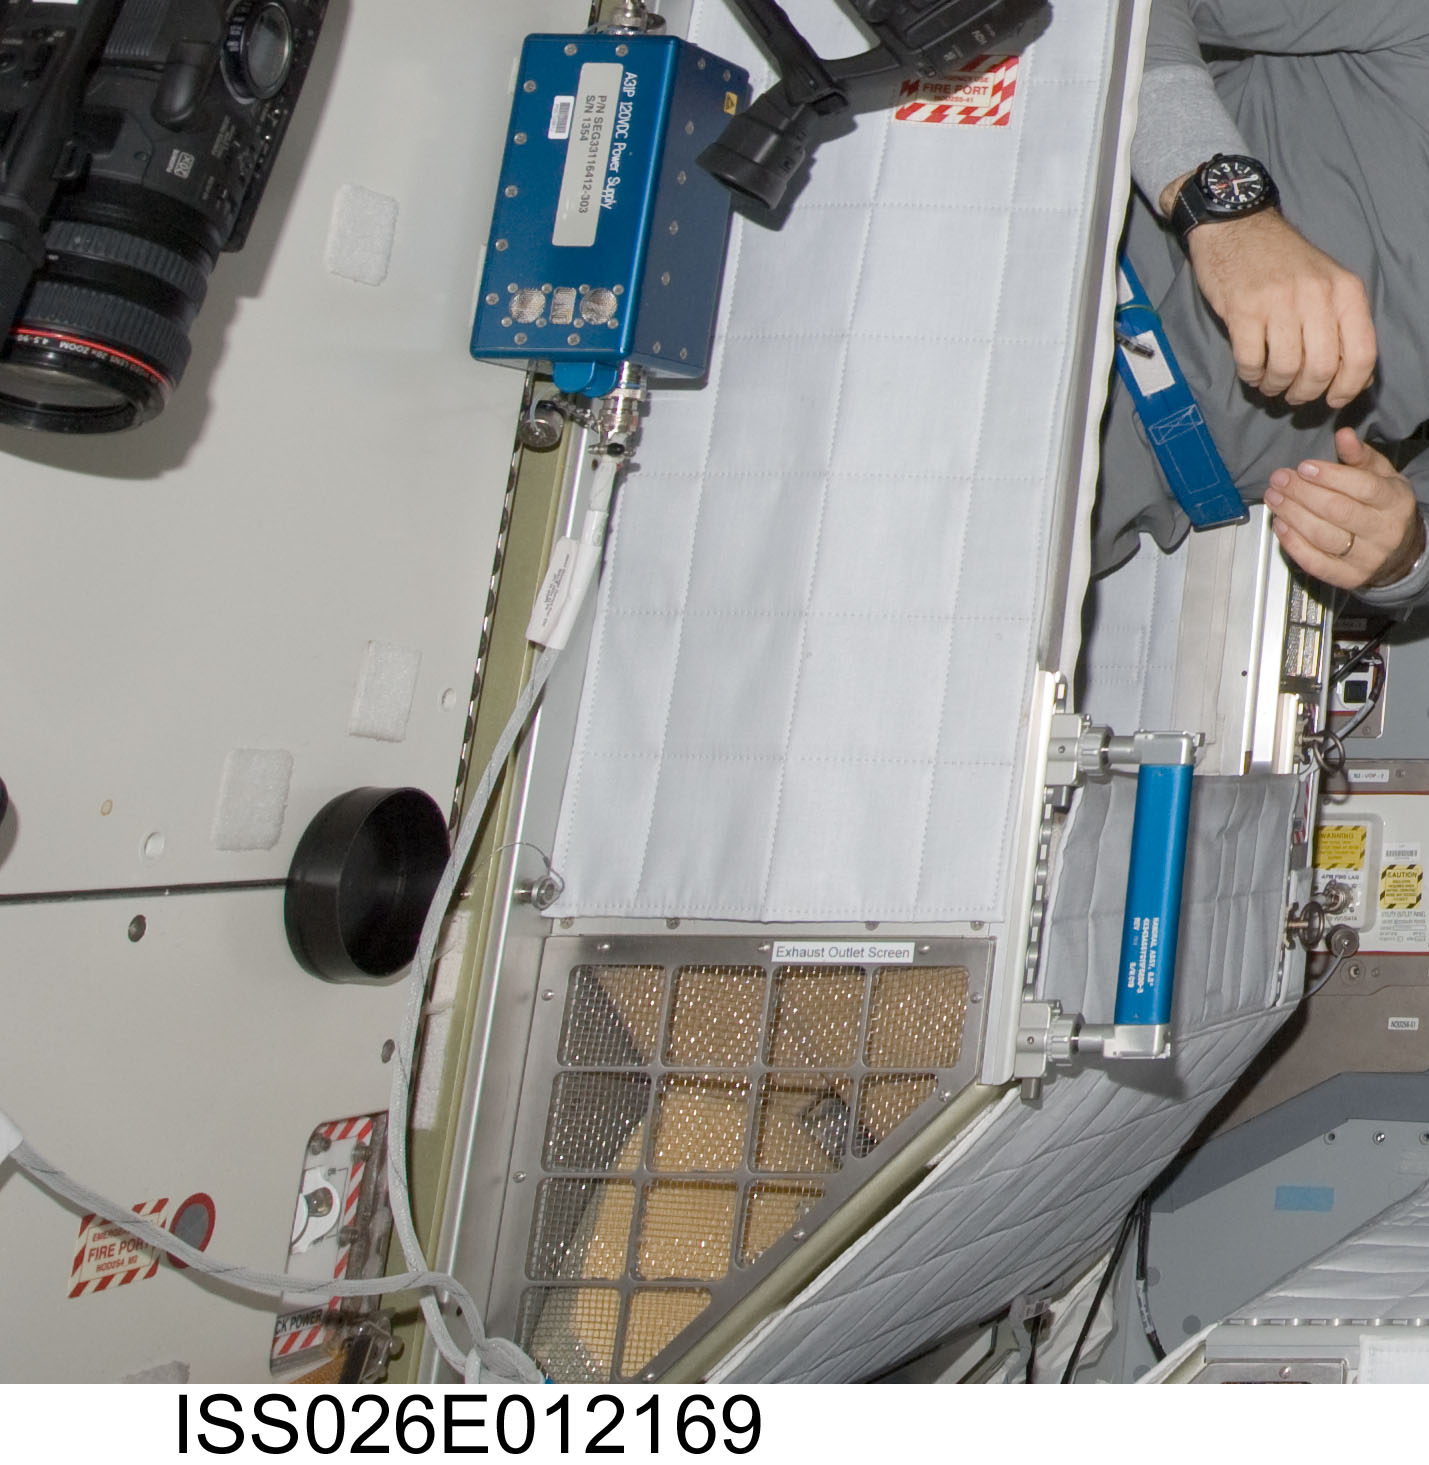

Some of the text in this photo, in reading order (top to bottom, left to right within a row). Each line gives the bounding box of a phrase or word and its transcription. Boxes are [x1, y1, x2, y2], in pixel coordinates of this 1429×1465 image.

[921, 83, 989, 97] FIRE PORT
[597, 94, 609, 114] P/N
[579, 94, 598, 142] S/N 1354
[616, 101, 636, 139] 120VDC
[609, 141, 629, 173] Power
[599, 177, 622, 210] Supply
[59, 340, 90, 356] ZOOM
[1386, 871, 1418, 879] CAUTION
[776, 944, 911, 959] Exhaust Outlet Screen
[87, 1241, 120, 1263] FIRE
[290, 1309, 323, 1332] POWER
